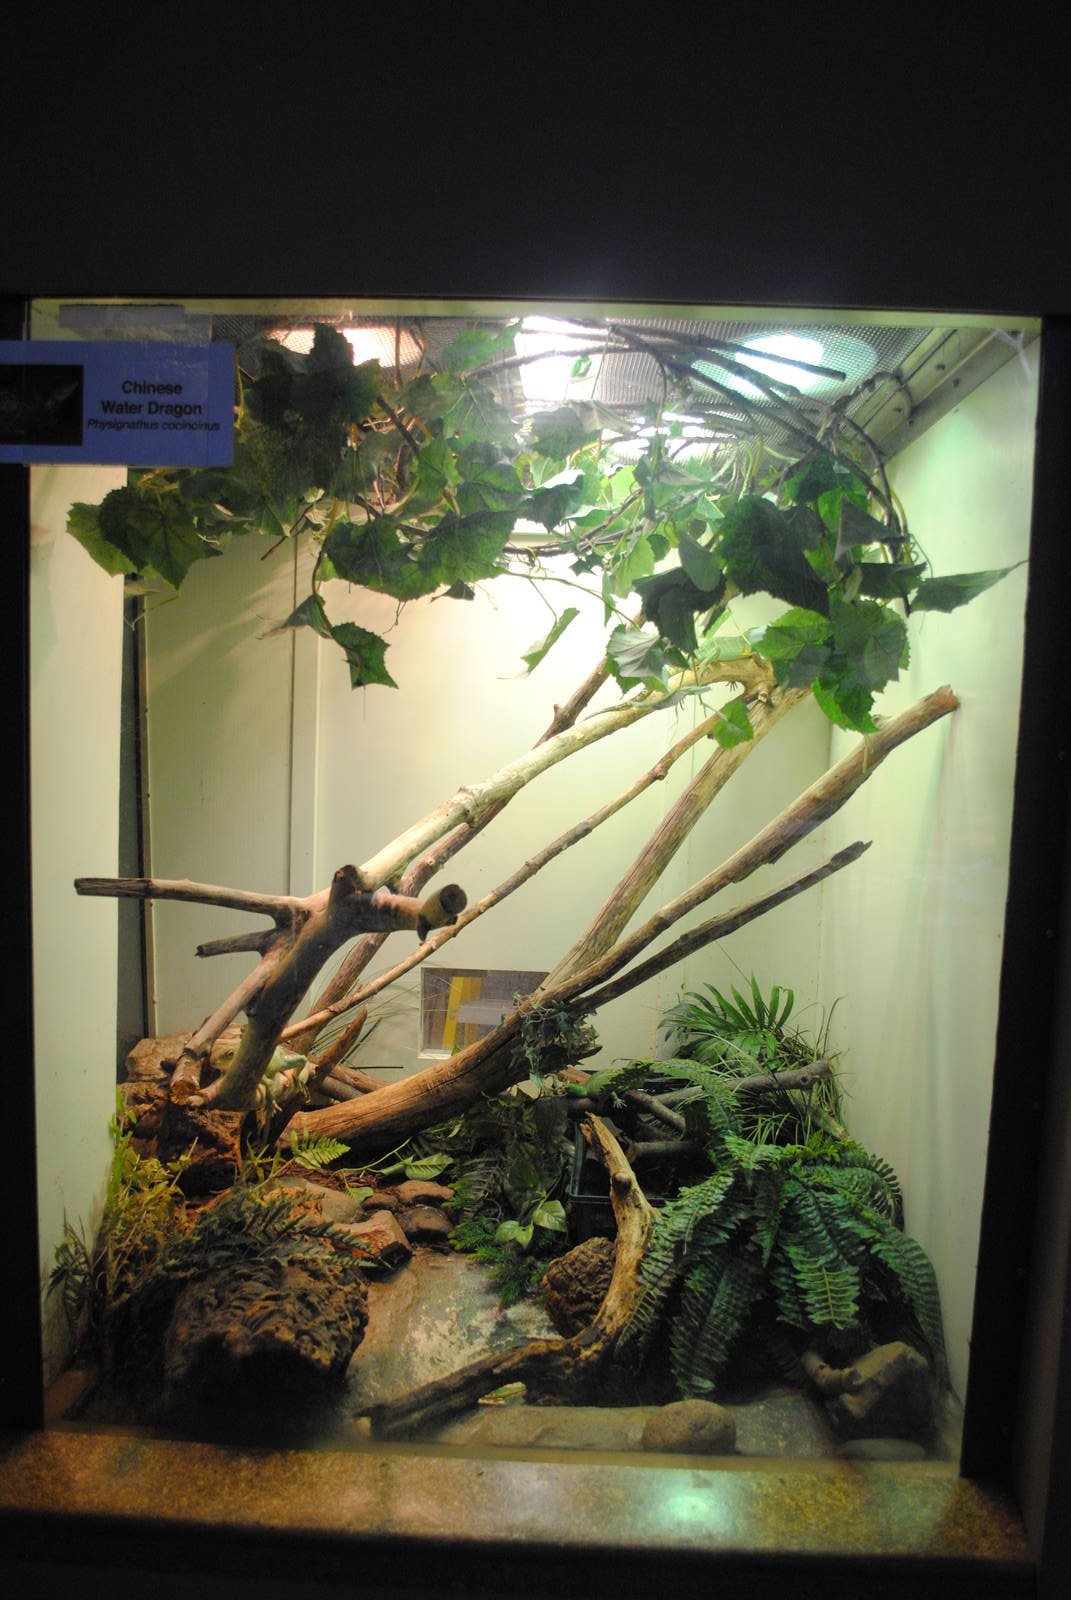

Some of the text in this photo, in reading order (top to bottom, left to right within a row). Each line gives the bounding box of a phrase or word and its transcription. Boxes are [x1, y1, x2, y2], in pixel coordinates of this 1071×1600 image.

[121, 380, 182, 394] Chinese
[101, 400, 202, 418] Water Dragon
[87, 418, 159, 432] Physignathus
